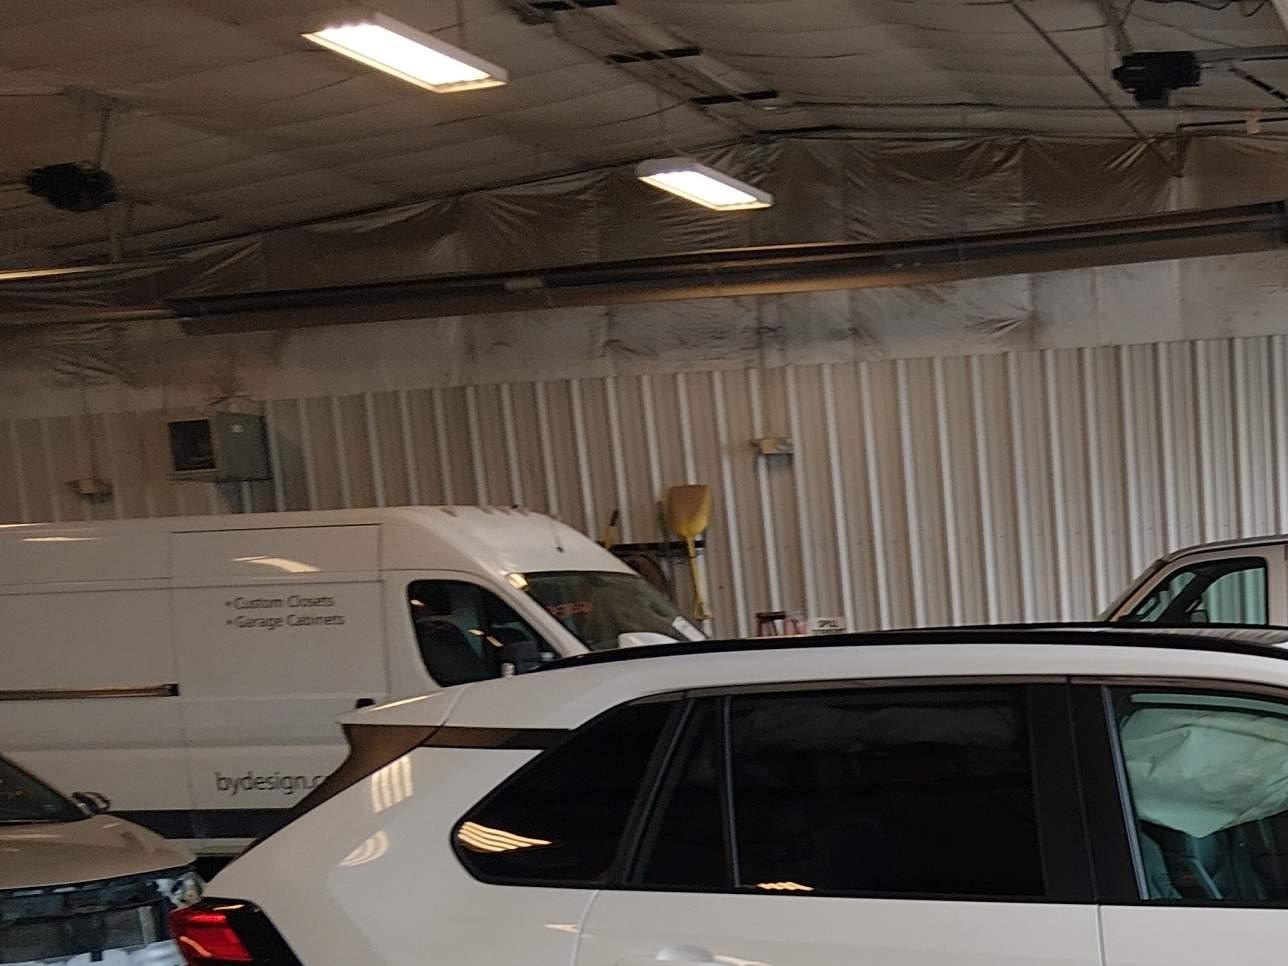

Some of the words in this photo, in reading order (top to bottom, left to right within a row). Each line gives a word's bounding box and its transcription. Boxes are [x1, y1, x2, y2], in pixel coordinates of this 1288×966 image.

[233, 596, 283, 610] Custom
[286, 594, 336, 608] Closets
[235, 615, 284, 631] Garage
[286, 613, 346, 627] Cabinets
[214, 770, 328, 796] bydesign.c
